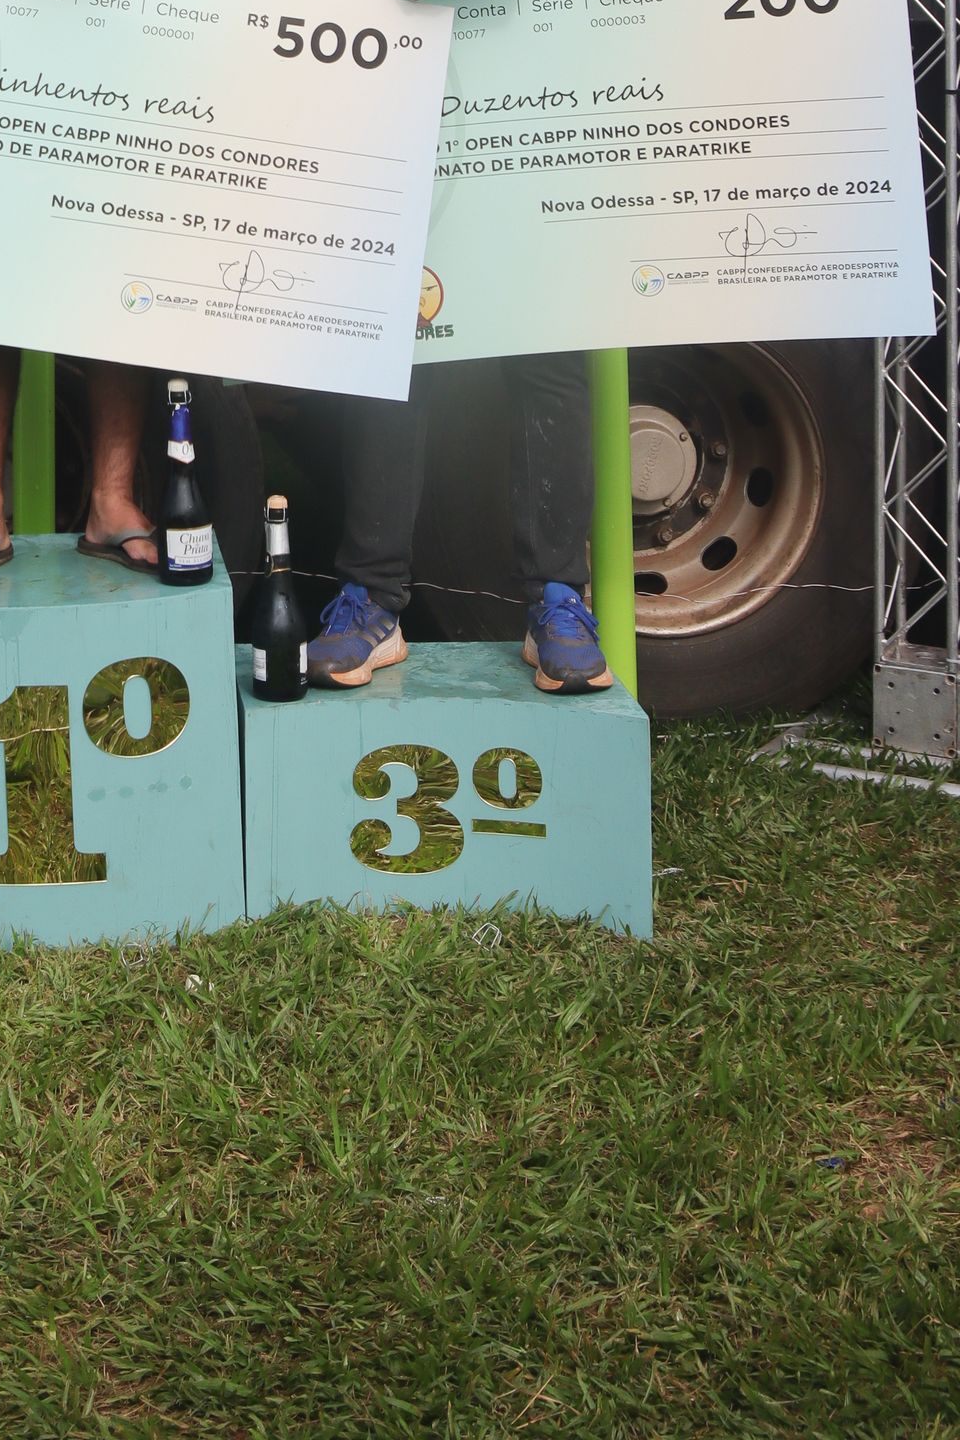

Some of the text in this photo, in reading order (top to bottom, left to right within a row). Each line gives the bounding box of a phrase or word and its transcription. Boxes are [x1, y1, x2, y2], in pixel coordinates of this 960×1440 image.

[4, 5, 40, 19] 10077
[85, 16, 107, 29] 001
[141, 24, 195, 41] 0000001
[155, 1, 222, 24] Cheque
[247, 13, 270, 29] R$
[452, 14, 647, 41] 10077 001 0000003
[456, 3, 506, 20] Conta
[143, 95, 214, 124] reais
[441, 77, 665, 118] Duzentos reais
[51, 123, 111, 143] CABPP
[114, 132, 173, 153] NINHO
[177, 141, 215, 159] DOS
[220, 147, 319, 174] CONDORES
[444, 139, 459, 153] 1º
[464, 134, 513, 151] OPEN
[518, 128, 577, 146] CABPP
[582, 123, 640, 141] NINHO
[645, 120, 683, 136] DOS
[688, 113, 790, 133] CONDORES
[9, 140, 33, 156] DE
[37, 144, 149, 173] PARAMOTOR
[154, 161, 166, 176] E
[170, 163, 268, 190] PARATRIKE
[490, 157, 514, 172] DE
[519, 148, 631, 168] PARAMOTOR
[636, 147, 647, 160] E
[652, 139, 752, 159] PARATRIKE
[540, 178, 892, 213] Nova Odessa SP, 17 de março de 2024
[50, 193, 395, 256] Nova Odessa SP, 17 de março de 2024
[716, 275, 768, 285] BRASILEIRA
[782, 272, 838, 282] PARAMOTOR
[849, 270, 898, 279] PARATRIKE
[746, 259, 899, 276] CONFEDERAÇÃO AERODESPORTIVA
[203, 308, 380, 341] BRASILEIRA PARAMOTOR PARATRIKE
[204, 298, 234, 309] CABPP
[233, 302, 306, 320] CONFEDERAÇÃO
[306, 313, 384, 332] AERODESPORTIVA
